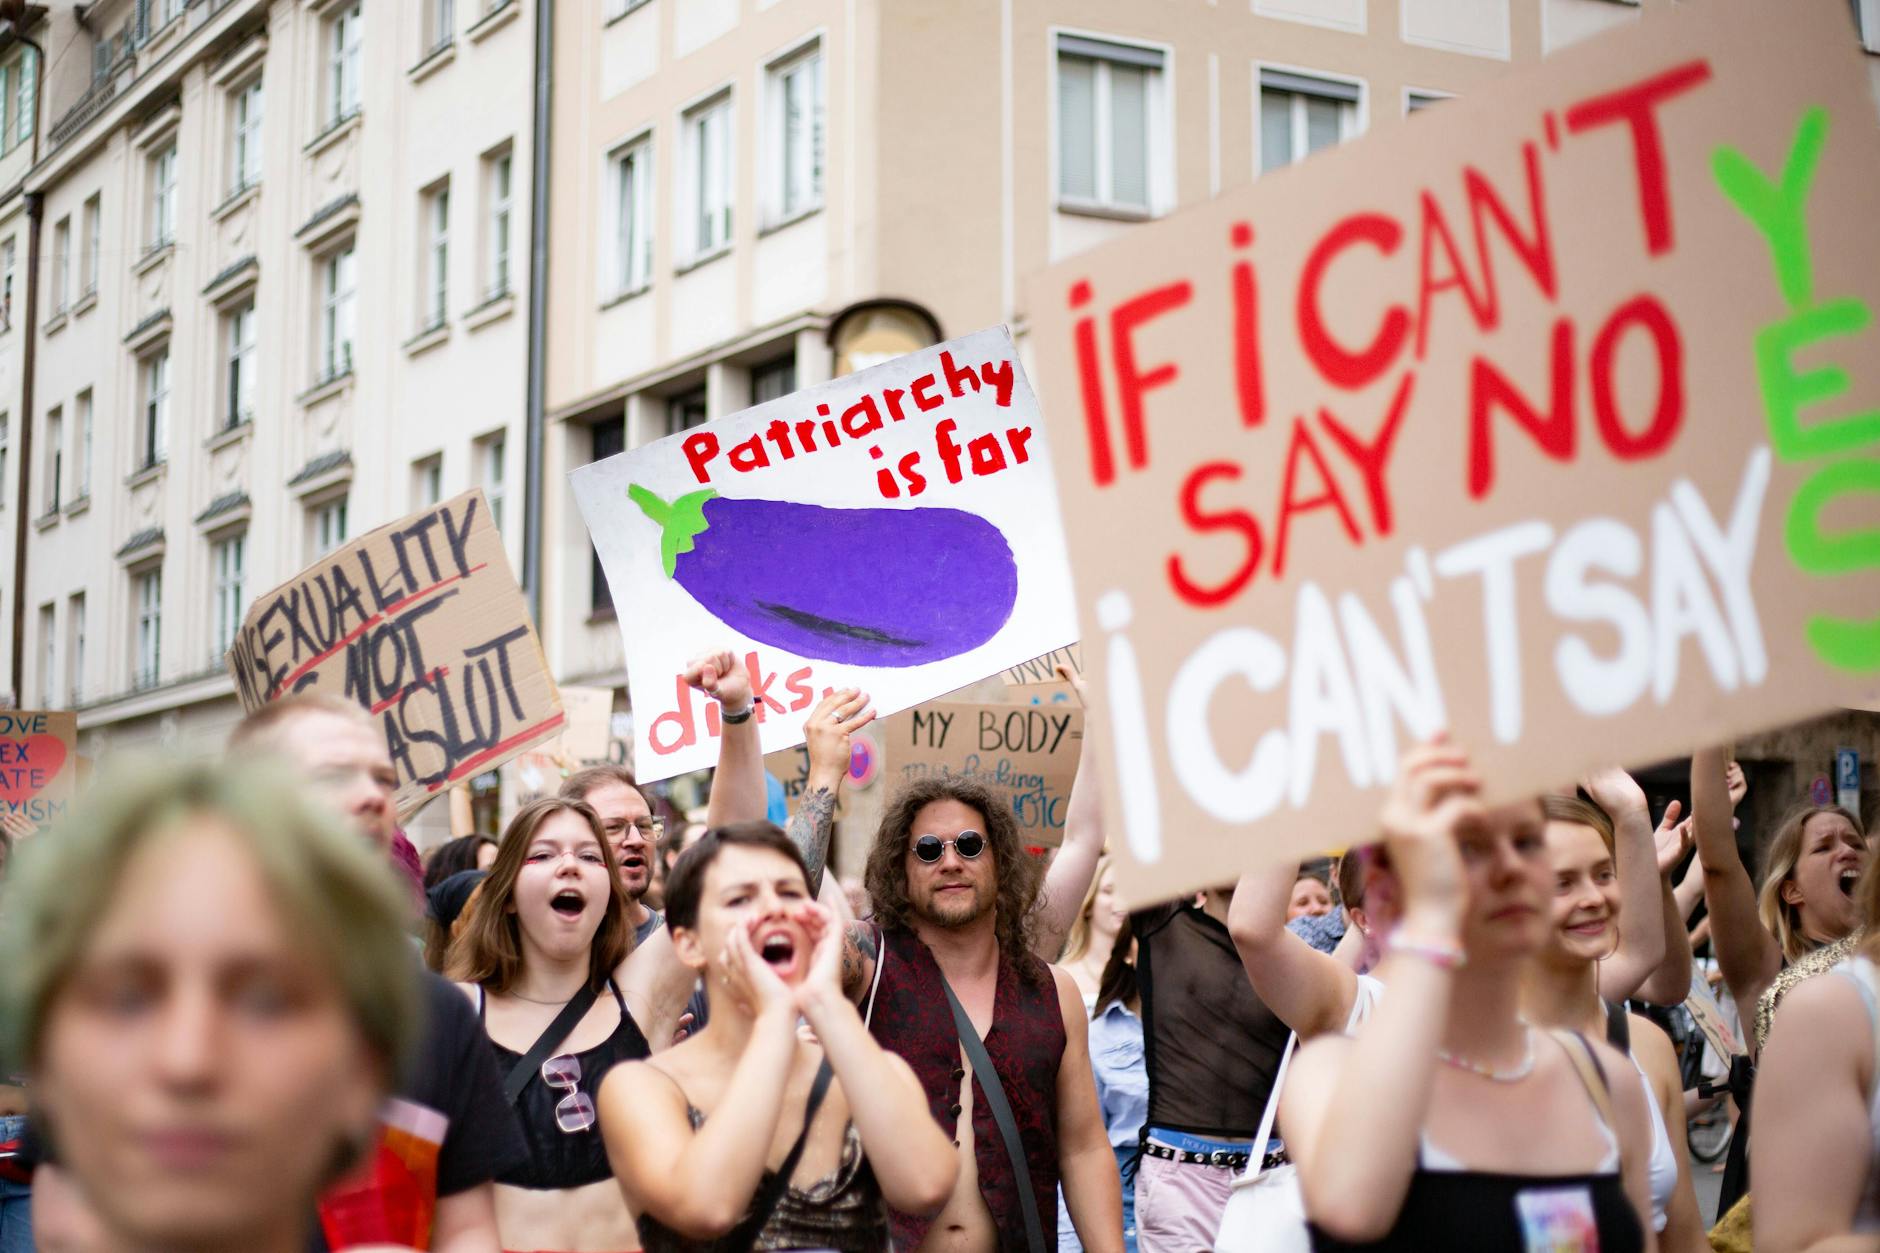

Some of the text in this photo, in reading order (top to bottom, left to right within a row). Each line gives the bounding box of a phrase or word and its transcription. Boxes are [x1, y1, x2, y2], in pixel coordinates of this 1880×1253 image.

[1293, 58, 1714, 393] CAN'T
[680, 350, 1015, 484] Patriarchy
[868, 417, 1033, 500] is for
[1162, 292, 1689, 613] SAY NO
[1543, 444, 1772, 716] SAY
[345, 588, 460, 712] NOT
[0, 714, 48, 735] OVE
[0, 742, 30, 765] EX
[912, 709, 954, 749] MY
[0, 767, 46, 791] ATE
